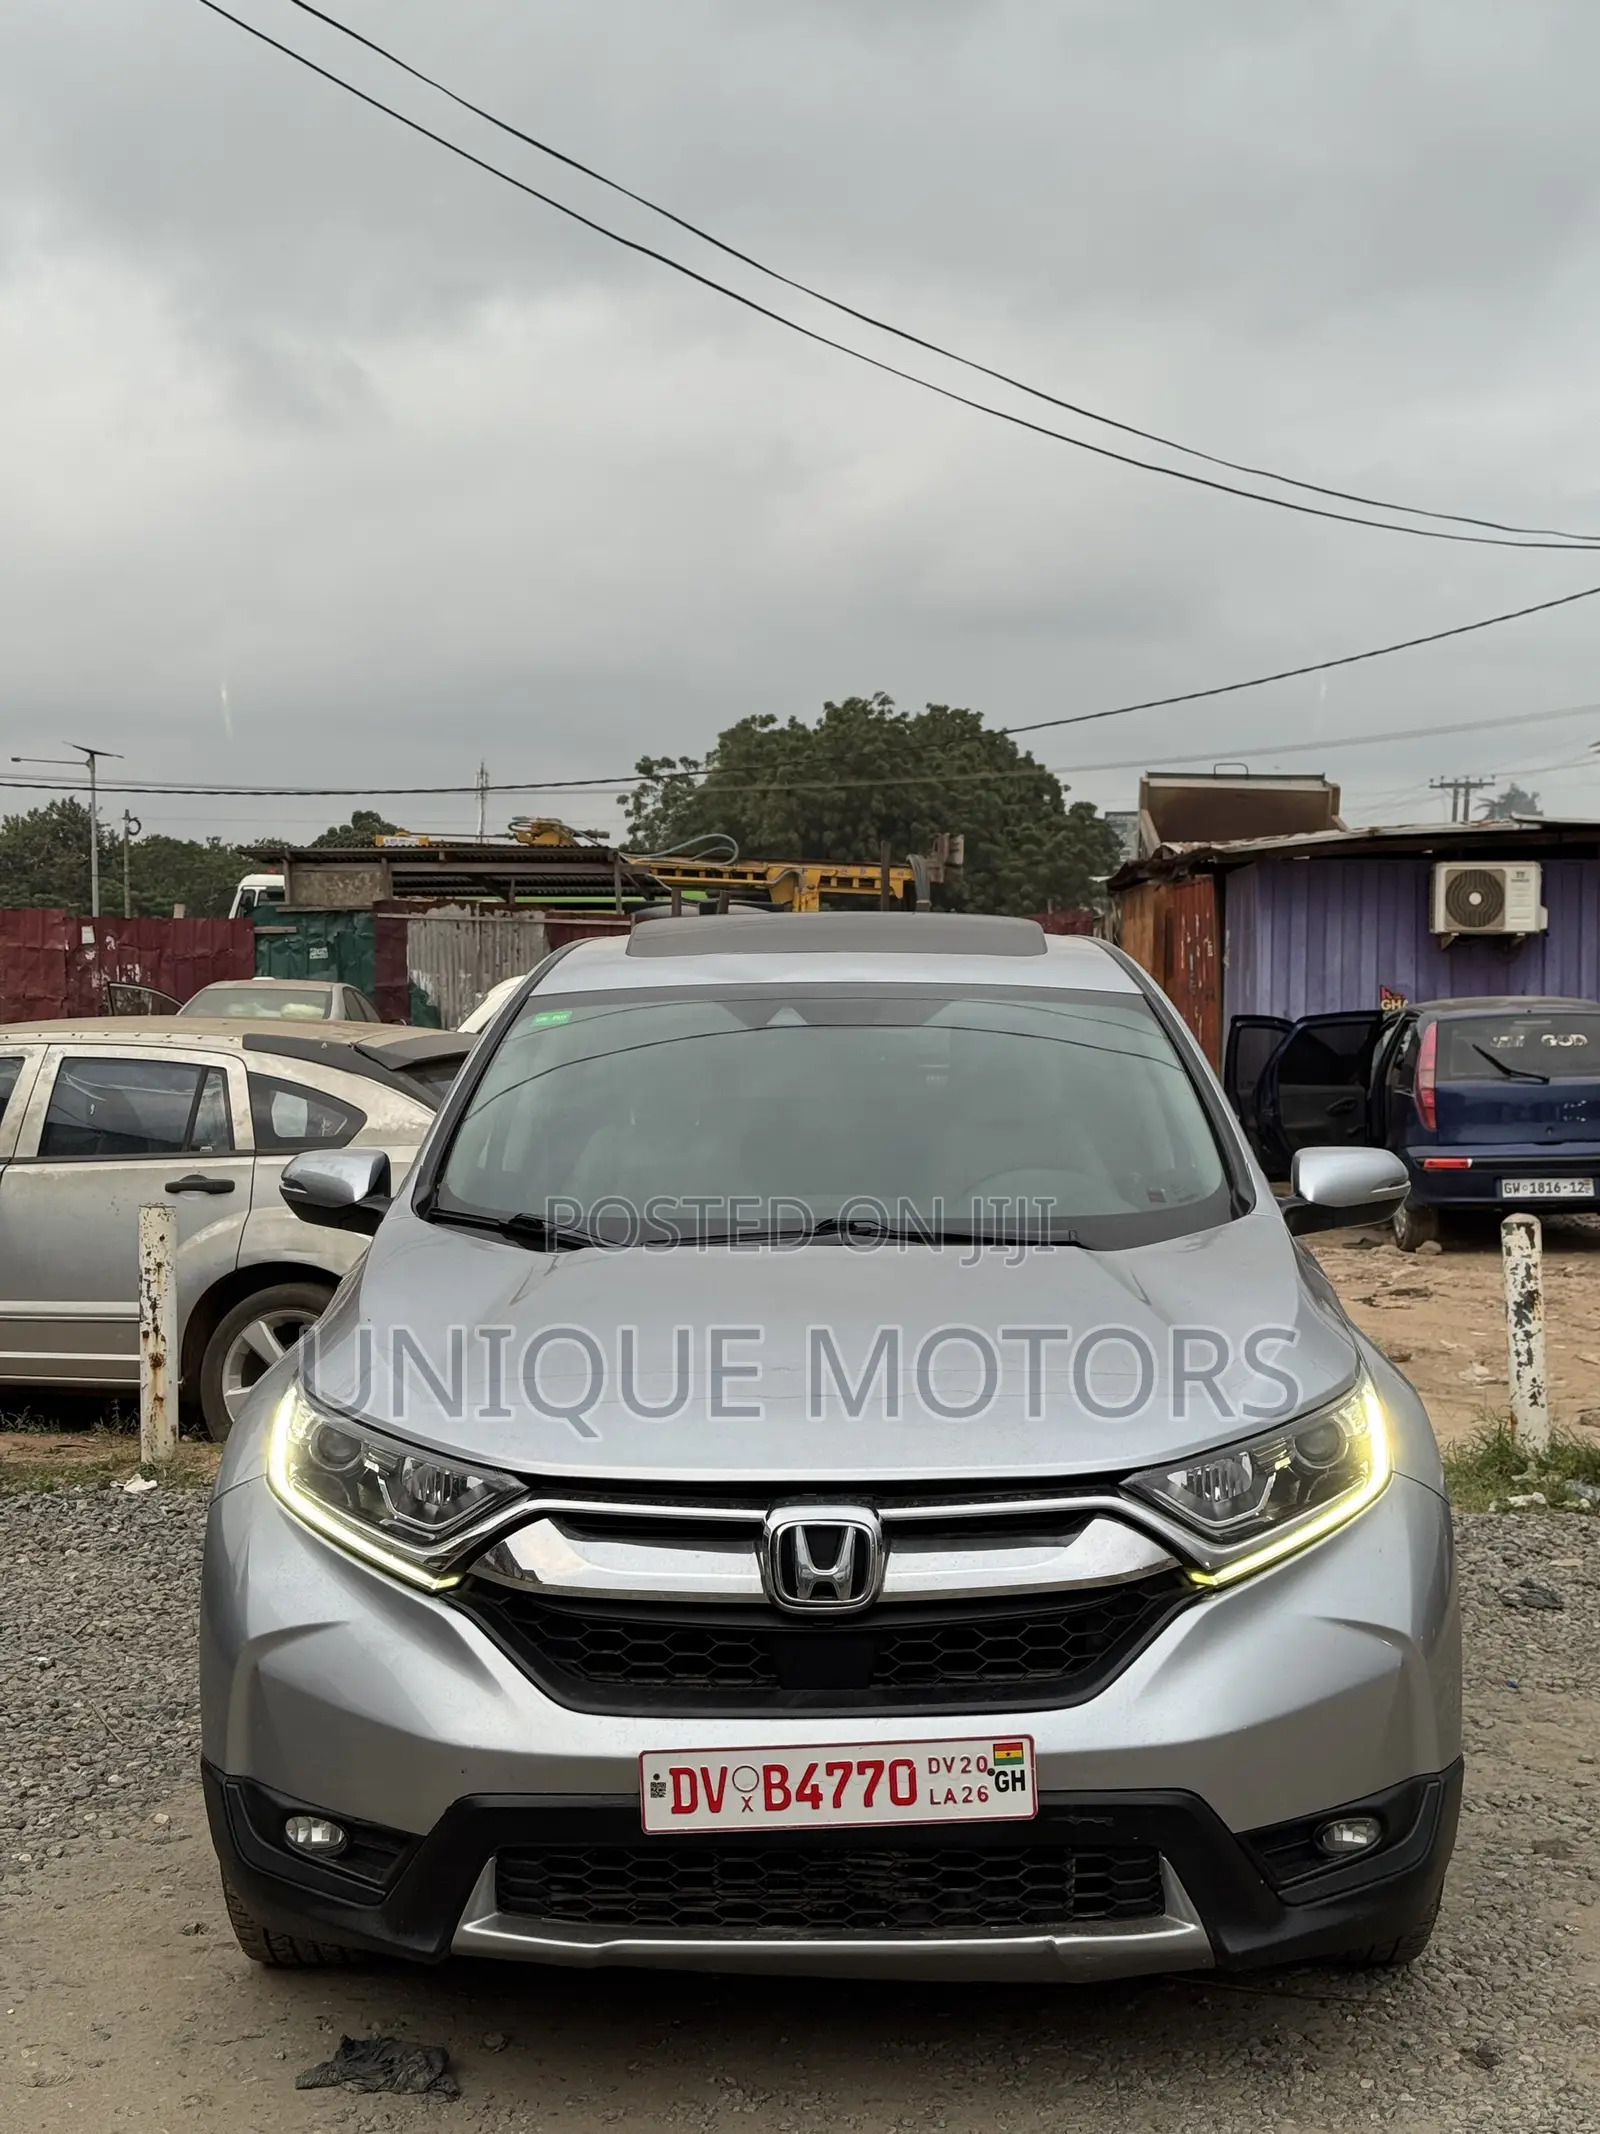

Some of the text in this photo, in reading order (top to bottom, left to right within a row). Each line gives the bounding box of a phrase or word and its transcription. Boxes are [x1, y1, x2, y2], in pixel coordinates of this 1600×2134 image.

[1504, 1182, 1520, 1194] GW
[928, 1755, 988, 1775] DV20
[669, 1765, 728, 1814] DV
[763, 1758, 917, 1812] B4770
[994, 1769, 1026, 1793] GH
[930, 1785, 990, 1806] LA26
